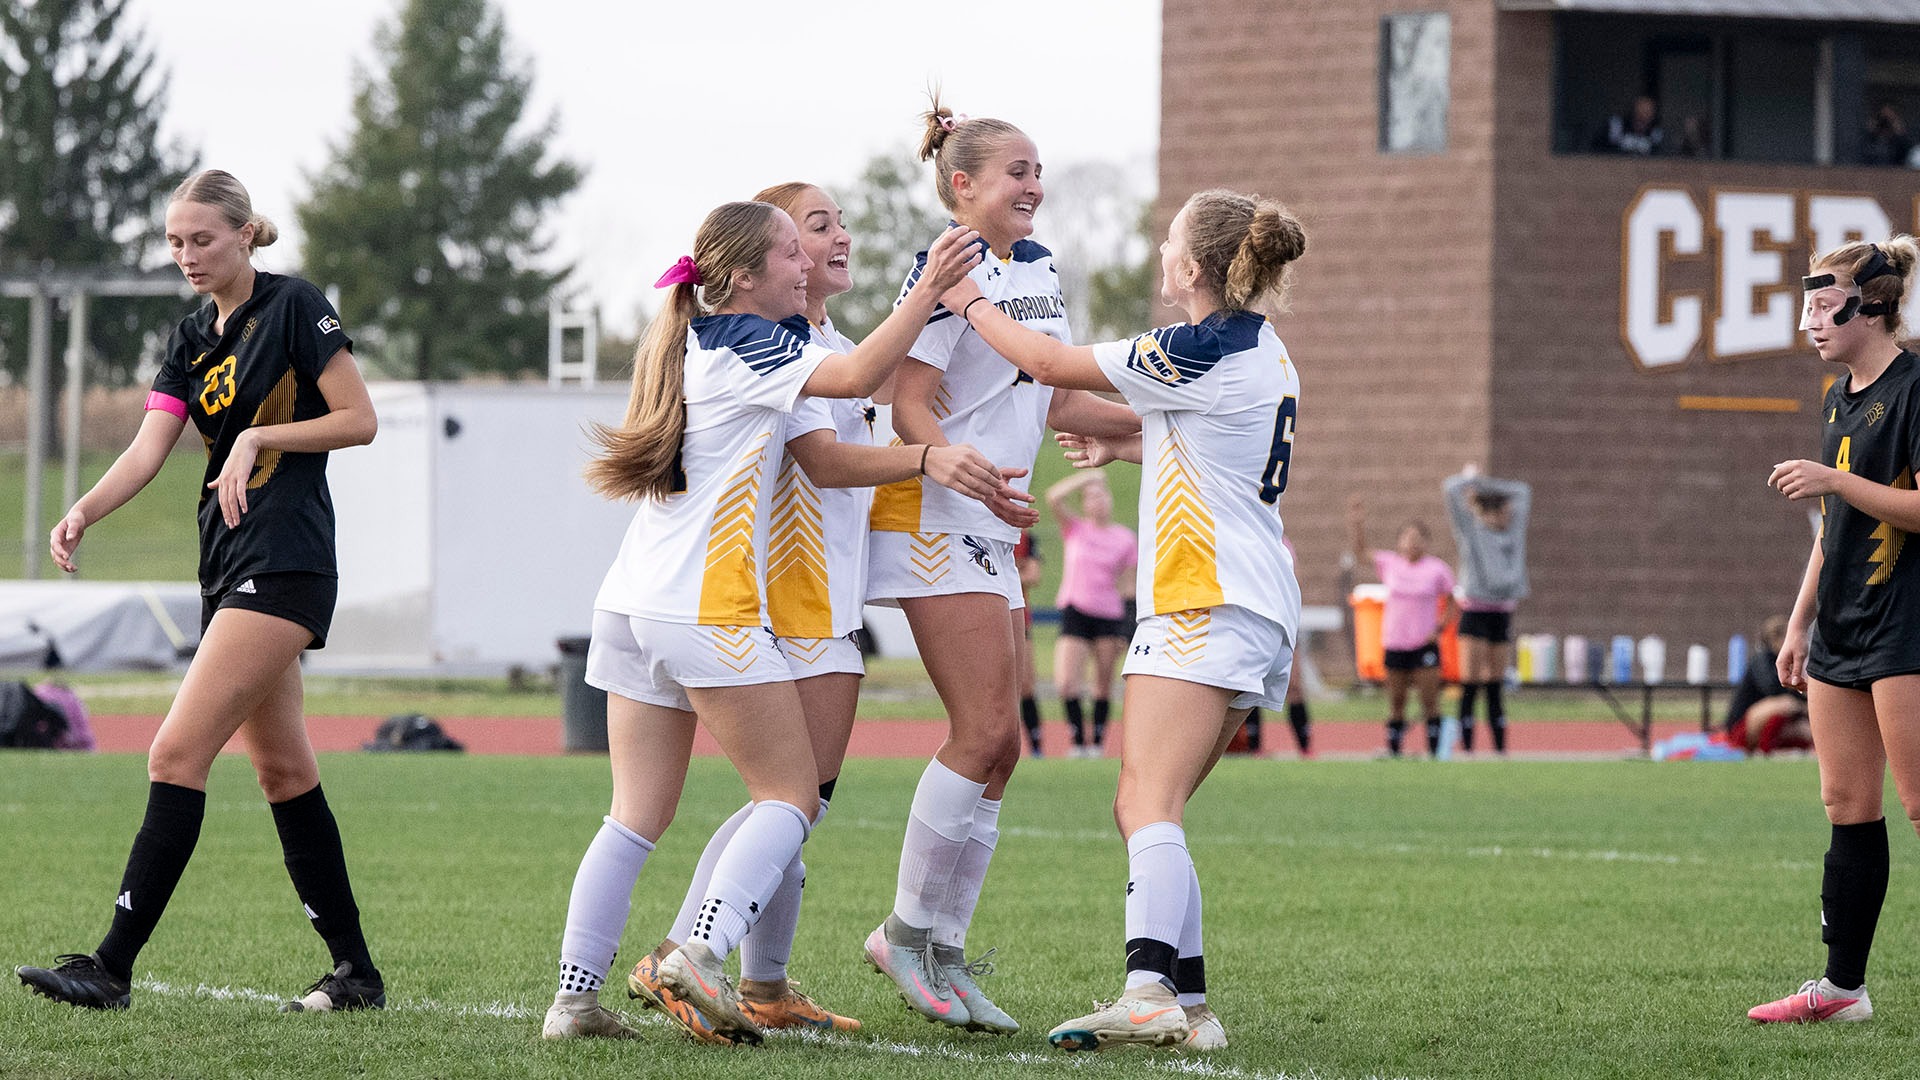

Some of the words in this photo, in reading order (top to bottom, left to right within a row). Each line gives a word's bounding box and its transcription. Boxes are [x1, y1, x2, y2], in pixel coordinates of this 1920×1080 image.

[199, 354, 237, 416] 23
[1259, 393, 1297, 506] 6
[1835, 436, 1851, 472] 4
